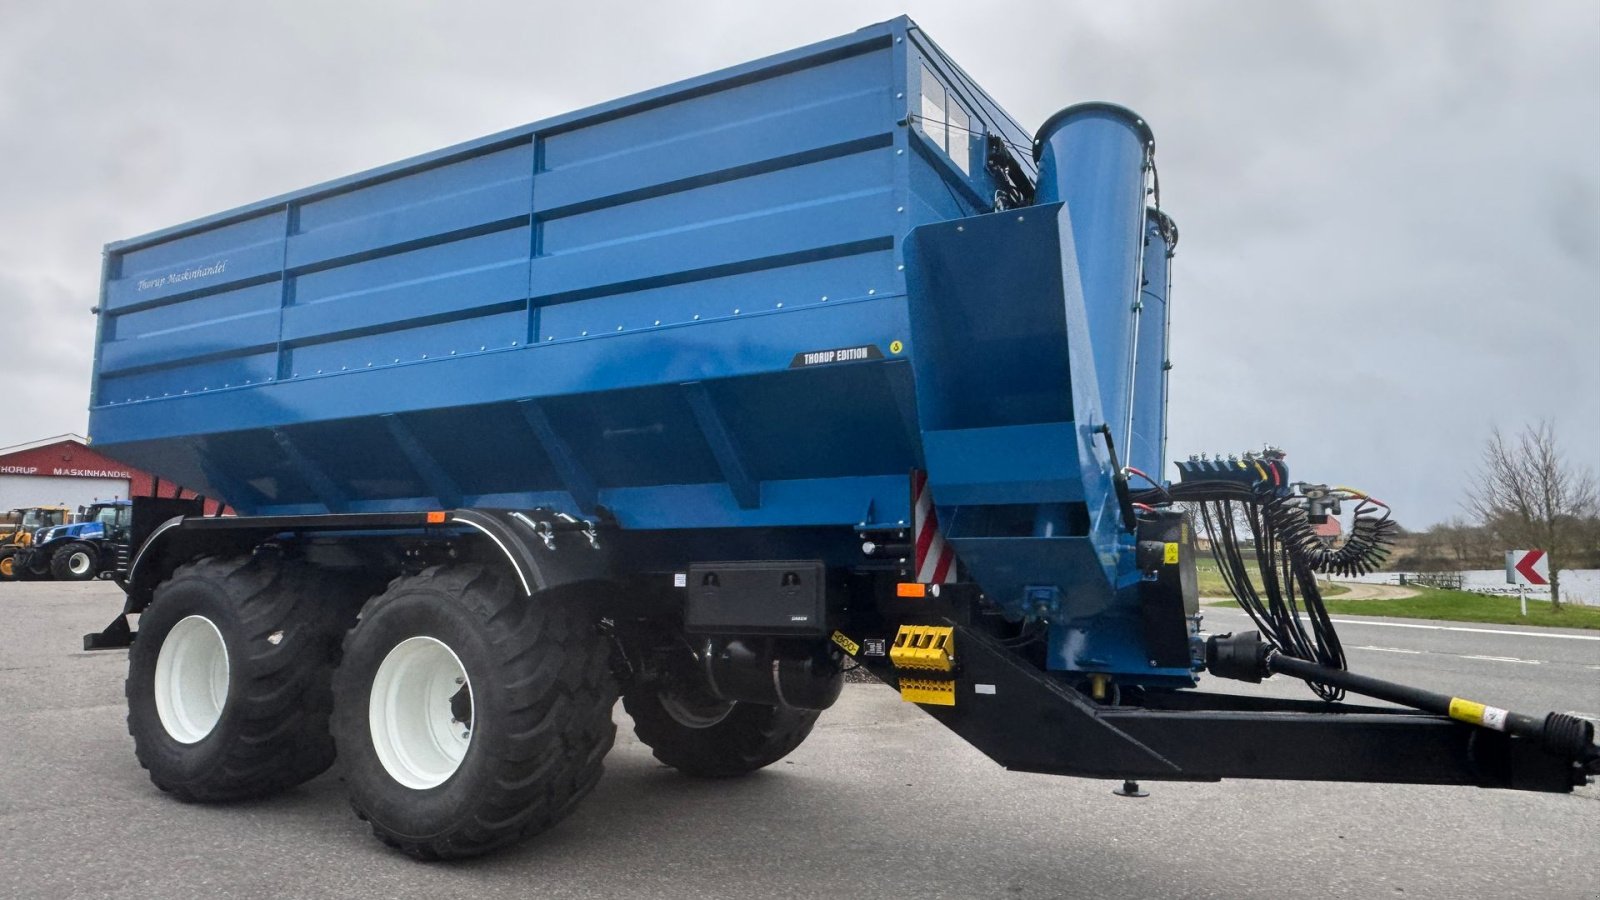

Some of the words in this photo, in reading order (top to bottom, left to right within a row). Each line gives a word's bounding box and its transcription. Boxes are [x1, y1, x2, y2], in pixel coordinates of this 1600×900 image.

[804, 351, 835, 365] THORUP
[836, 347, 868, 361] EDITION
[0, 466, 37, 474] HORUP
[53, 468, 131, 478] MASKINHANDEL
